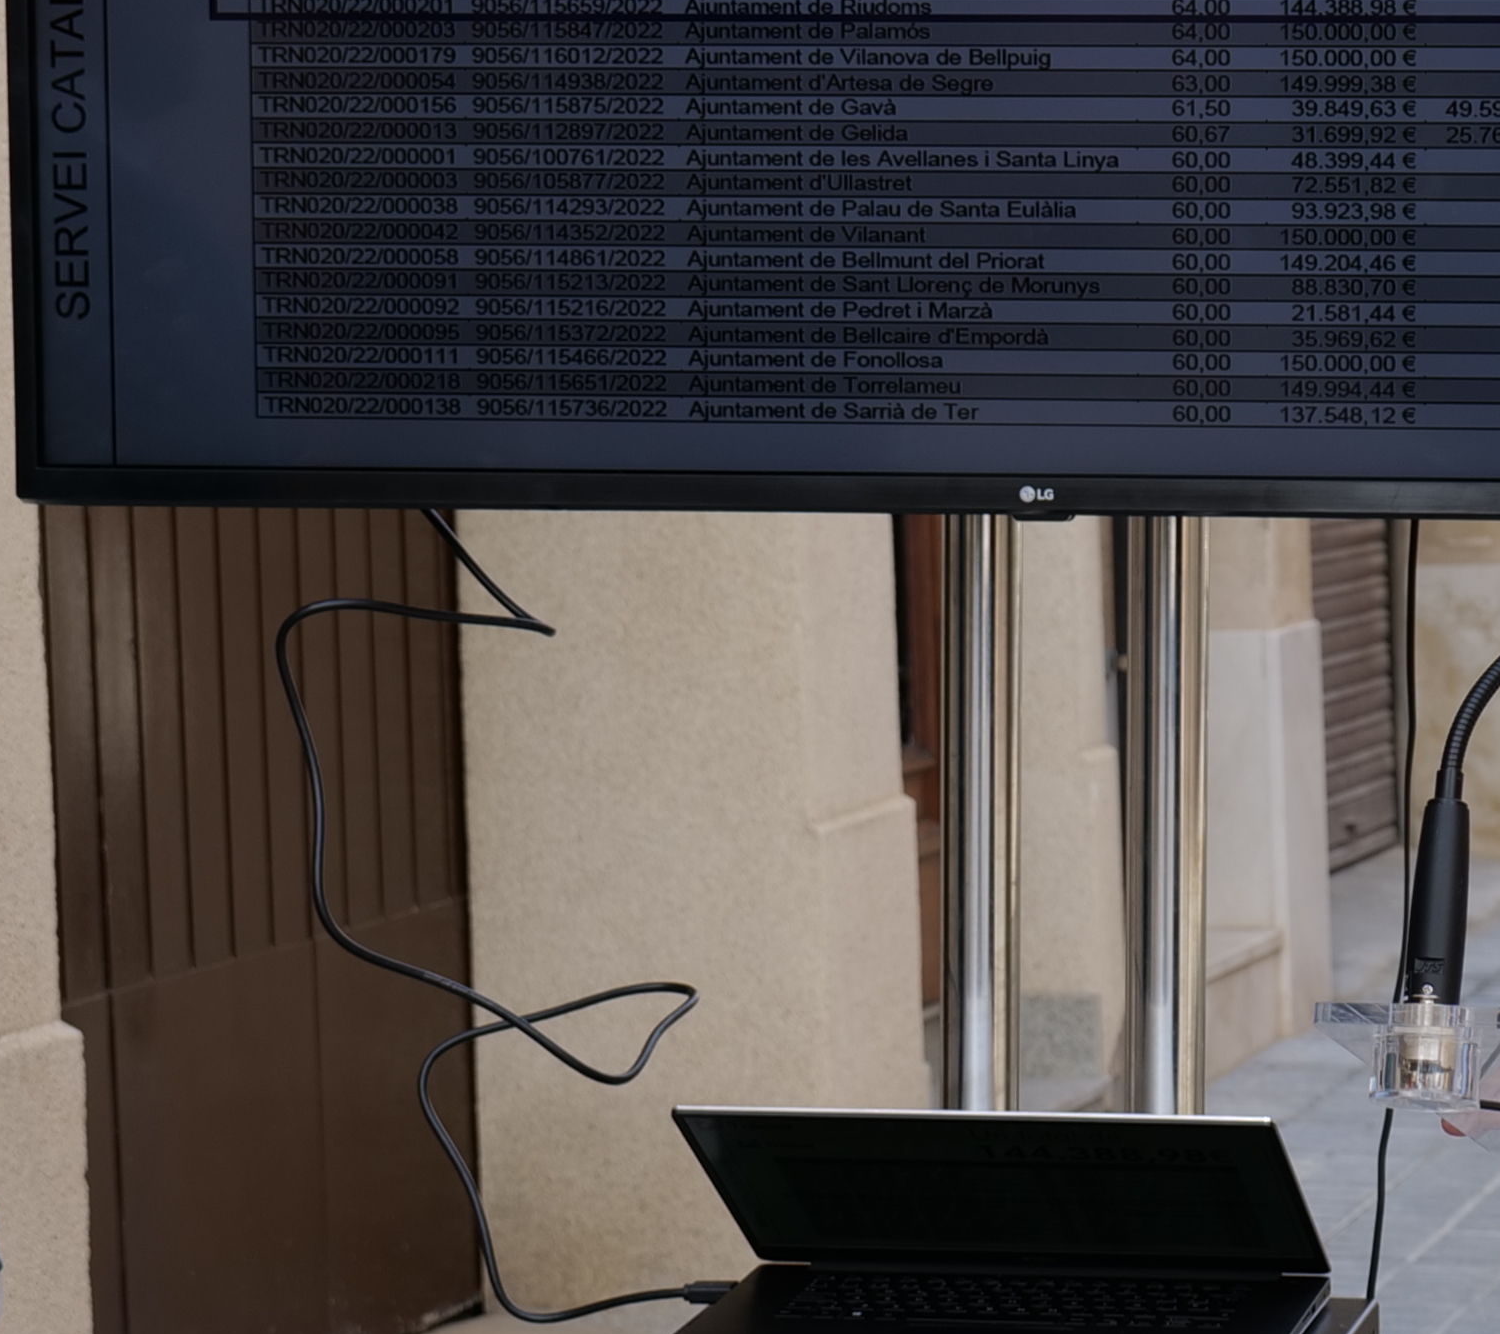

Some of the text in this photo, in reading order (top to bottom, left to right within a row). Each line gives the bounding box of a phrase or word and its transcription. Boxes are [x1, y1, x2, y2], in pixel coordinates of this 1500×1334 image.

[256, 47, 457, 65] TRN020/22/000179
[471, 47, 664, 65] 9056/116012/2022
[684, 49, 1052, 71] Ajuntament de Vilanova de Bellpuig
[1171, 49, 1231, 70] 64,00
[1279, 49, 1417, 70] 150.000,00 €
[258, 122, 458, 140] TRN020/22/000013
[472, 123, 665, 141] 9056/112897/2022
[685, 124, 909, 146] Ajuntament de Gelida
[1171, 125, 1231, 146] 60,67
[1291, 125, 1417, 146] 31.699,92 €
[54, 149, 91, 321] SERVEI
[260, 248, 460, 266] TRN020/22/000058
[474, 249, 666, 267] 9056/114861/2022
[686, 252, 1045, 274] Ajuntament de Bellmunt del Priorat
[1171, 254, 1231, 275] 60,00
[1279, 254, 1417, 275] 149.204,46 €
[262, 397, 462, 415] TRN020/22/000138
[476, 399, 668, 417] 9056/115736/2022
[688, 402, 980, 424] Ajuntament de Sarrià de Ter
[1172, 406, 1232, 427] 60,00
[1280, 406, 1416, 427] 137.548,12 €
[1036, 487, 1055, 502] LG
